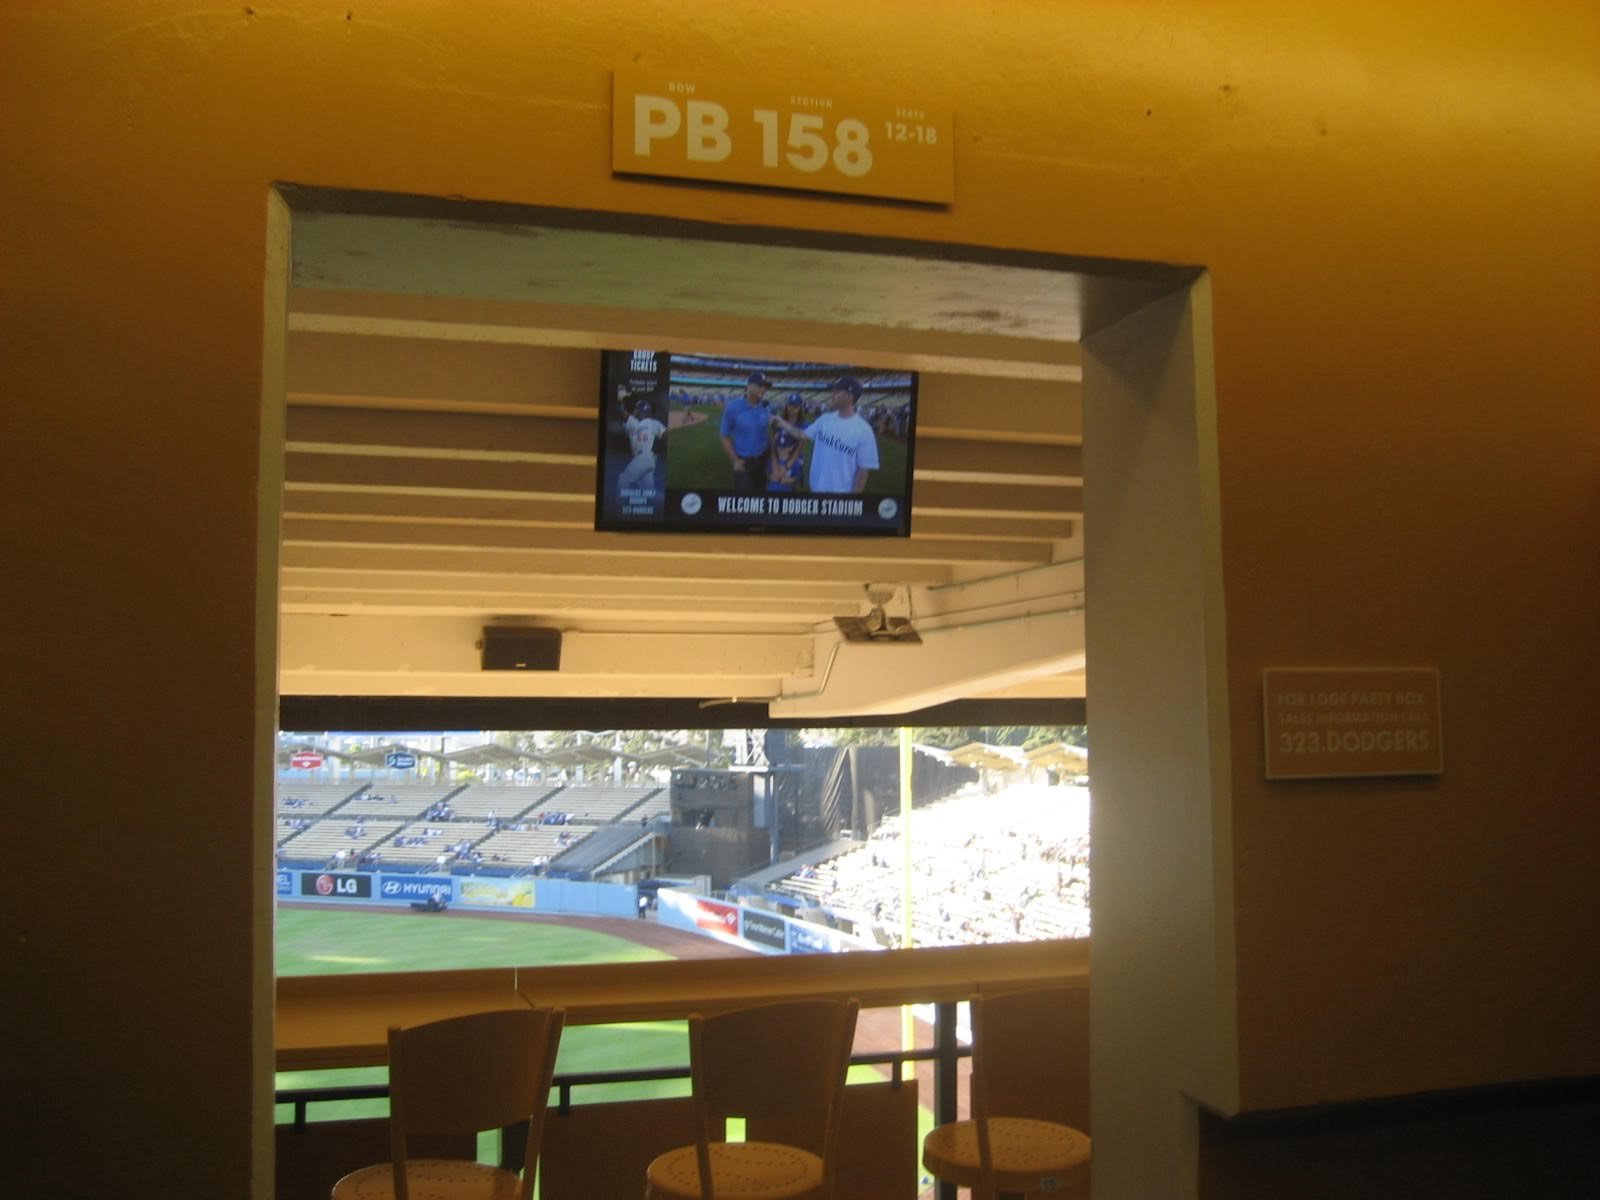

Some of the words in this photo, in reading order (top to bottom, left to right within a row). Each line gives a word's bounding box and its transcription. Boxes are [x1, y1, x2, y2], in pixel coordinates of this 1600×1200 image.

[668, 81, 695, 95] ROW
[790, 95, 833, 111] SECTION
[634, 94, 732, 163] PB
[753, 109, 873, 177] 158
[884, 121, 937, 145] 12-18
[718, 496, 765, 514] WELCOME
[768, 497, 780, 514] TO
[782, 498, 819, 515] DODGER
[821, 499, 864, 516] STADIUM
[1280, 728, 1431, 754] 323.DODGERS
[336, 878, 358, 894] LG
[403, 882, 452, 896] HYUNDAI
